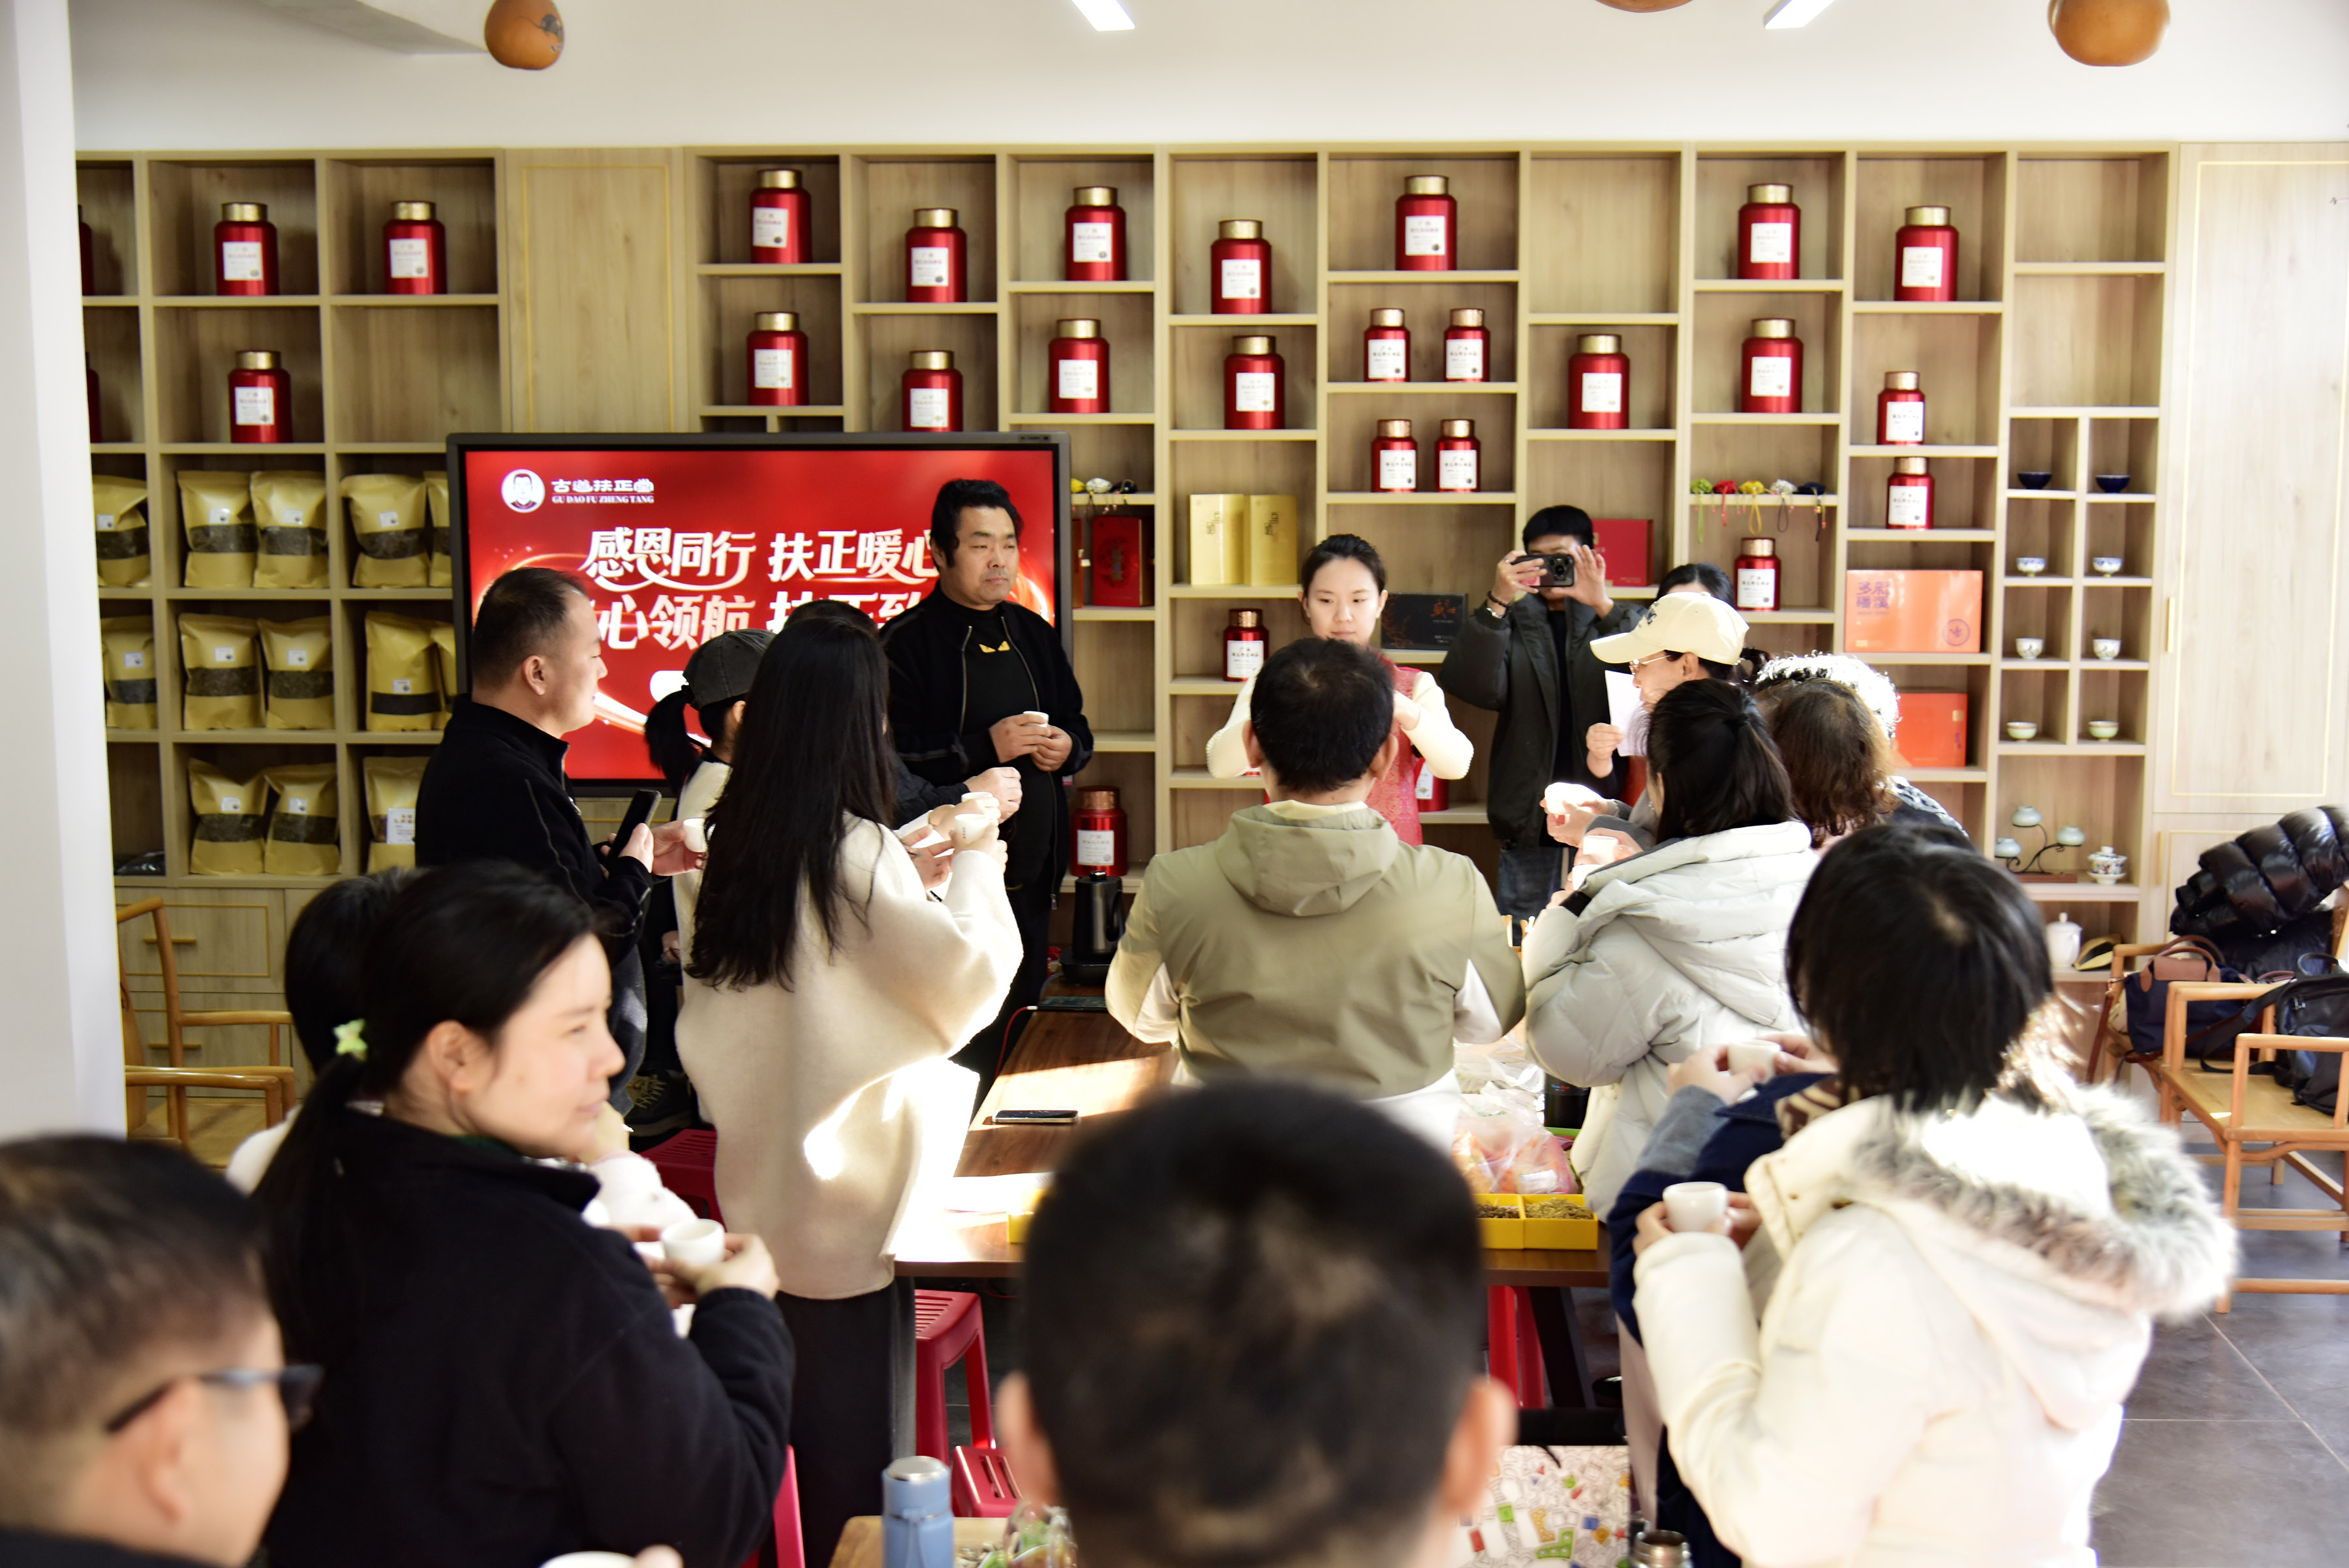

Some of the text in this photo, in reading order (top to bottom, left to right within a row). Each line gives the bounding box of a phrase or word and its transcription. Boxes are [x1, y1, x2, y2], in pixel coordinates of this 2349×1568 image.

[551, 478, 654, 493] 古道扶正堂
[578, 527, 940, 592] 感恩同行 扶正暖心
[590, 594, 756, 651] 心领航
